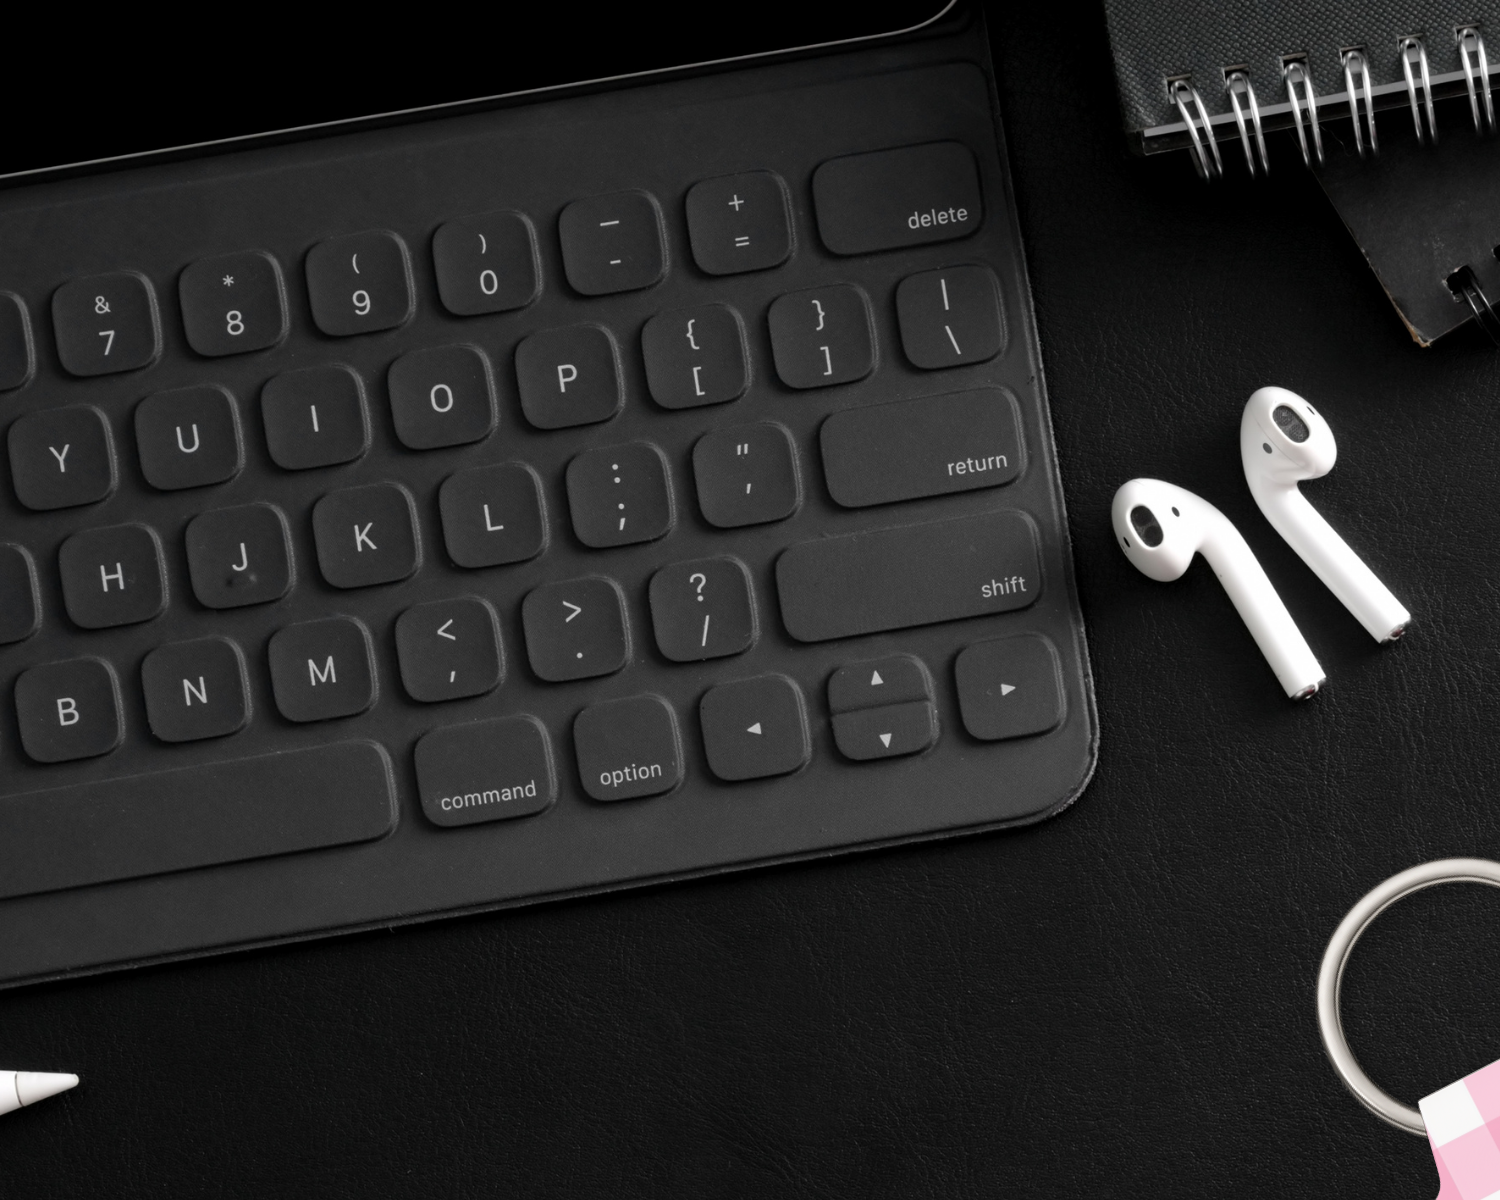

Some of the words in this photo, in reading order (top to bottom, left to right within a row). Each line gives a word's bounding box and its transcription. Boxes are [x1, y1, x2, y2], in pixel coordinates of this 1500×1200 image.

[907, 207, 968, 230] delete
[94, 295, 111, 315] &
[352, 289, 371, 316] 9
[226, 310, 245, 336] 8
[98, 329, 115, 356] 7
[557, 364, 578, 393] P
[175, 423, 200, 454] U
[48, 443, 70, 473] Y
[947, 455, 1008, 476] return
[483, 504, 504, 532] L
[353, 522, 378, 552] K
[231, 542, 248, 572] J
[99, 562, 125, 593] H
[689, 572, 707, 602] ?
[981, 575, 1027, 598] shift
[307, 655, 337, 687] M
[182, 676, 208, 707] N
[56, 697, 80, 727] B
[600, 764, 662, 788] option
[441, 779, 537, 811] command
